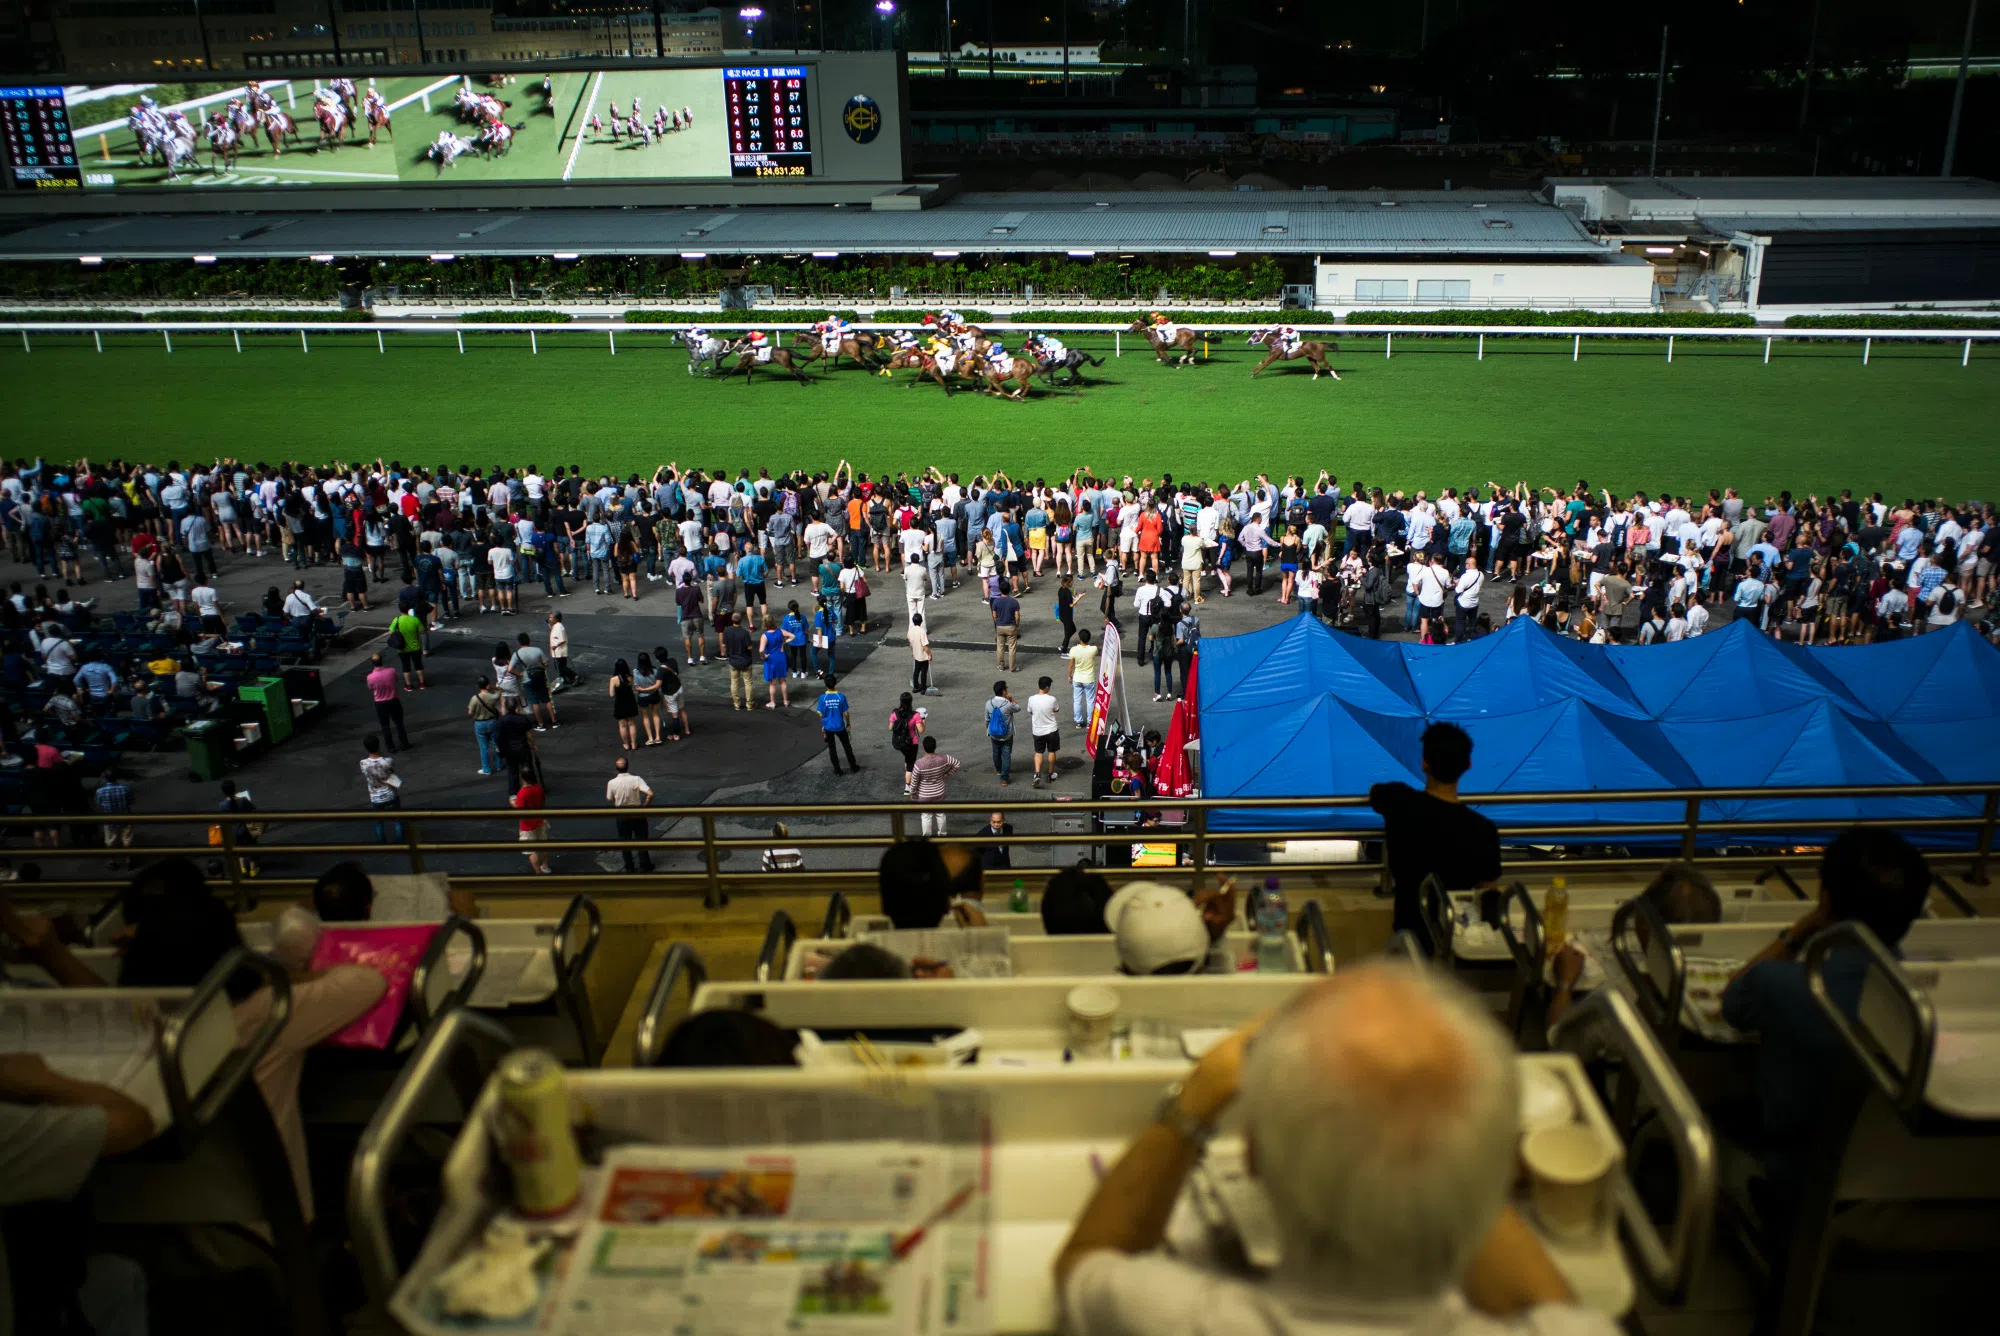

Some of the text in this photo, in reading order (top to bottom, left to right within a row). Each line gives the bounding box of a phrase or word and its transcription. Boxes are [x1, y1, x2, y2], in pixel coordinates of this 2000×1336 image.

[732, 80, 800, 90] 1 24 7 4.0
[732, 92, 799, 102] 2 4.2 8 57
[734, 105, 801, 114] 3 27 9 6.1
[734, 117, 801, 127] 4 10 10 87
[736, 130, 803, 139] 5 24 11 6.0
[736, 142, 803, 151] 6 6.7 12 83
[763, 167, 805, 176] 24,631,292
